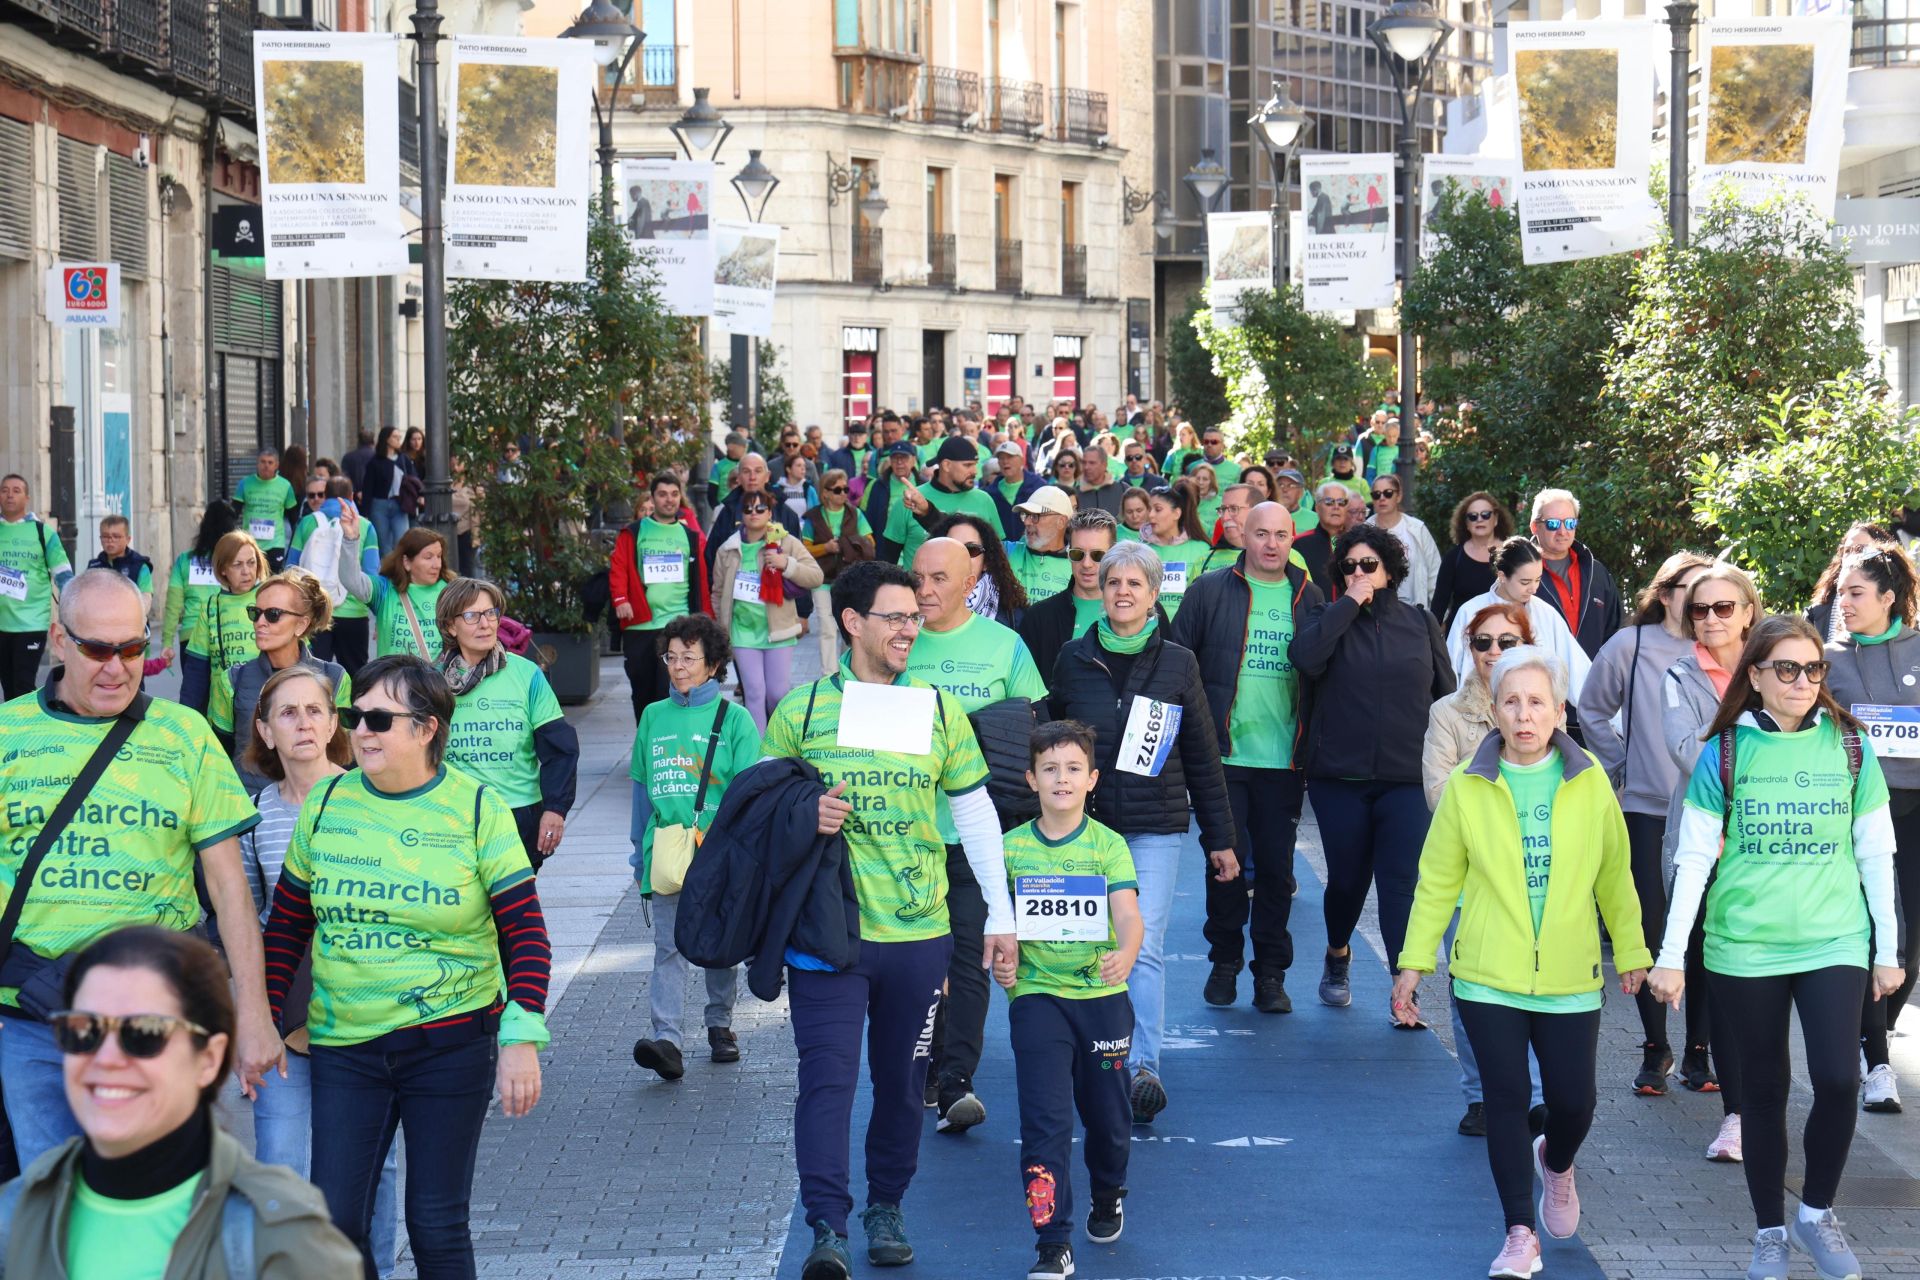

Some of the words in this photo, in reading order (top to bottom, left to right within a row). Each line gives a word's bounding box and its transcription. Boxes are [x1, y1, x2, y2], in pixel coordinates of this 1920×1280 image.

[310, 192, 334, 202] UNA
[453, 194, 464, 202] ES
[1836, 226, 1871, 238] DAN
[1866, 238, 1890, 246] ROMA
[648, 564, 680, 573] 11203
[0, 575, 25, 589] 8089
[223, 631, 256, 643] marc
[396, 628, 434, 638] cora
[210, 646, 245, 658] cotra
[1244, 642, 1279, 656] ontra
[1248, 657, 1292, 672] cánce
[464, 718, 523, 732] marcha
[1871, 724, 1918, 739] 6708
[446, 735, 492, 748] ontra
[20, 744, 64, 758] Iberdrola
[462, 750, 514, 762] cáncer
[652, 744, 664, 756] En
[824, 749, 875, 760] Valladolid
[652, 754, 693, 770] marcha
[652, 768, 686, 782] contra
[842, 767, 931, 789] marcha
[1750, 774, 1788, 784] Iberdrola
[652, 784, 662, 796] el
[662, 780, 699, 793] cánce
[7, 800, 45, 828] En
[1744, 798, 1770, 816] En
[1776, 798, 1849, 816] marcha
[321, 826, 358, 836] Iberdrola
[1745, 818, 1814, 836] contra
[10, 830, 111, 858] cntra
[1747, 838, 1762, 854] el
[1768, 838, 1839, 855] cáncer
[324, 852, 382, 867] Valladolid
[41, 862, 156, 892] cáncer
[336, 879, 461, 906] marcha
[316, 902, 390, 925] ontra
[1026, 899, 1098, 916] 28810
